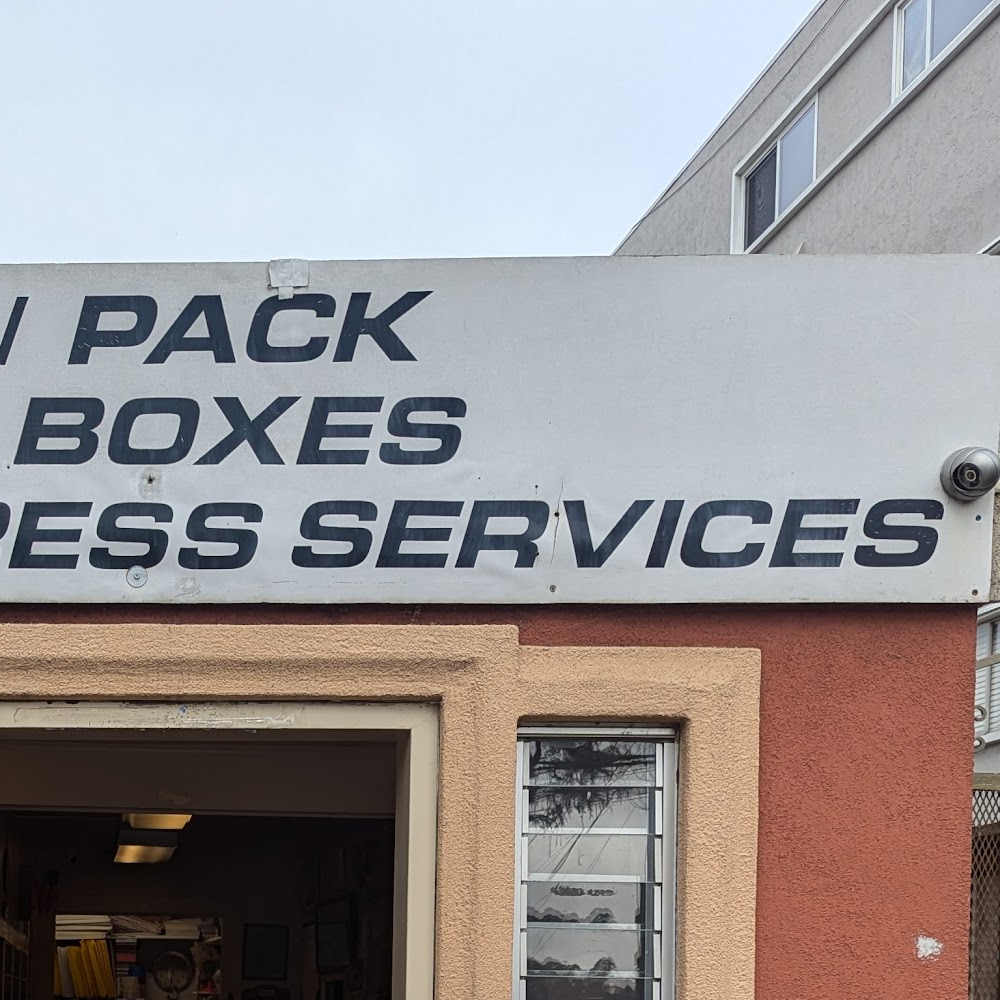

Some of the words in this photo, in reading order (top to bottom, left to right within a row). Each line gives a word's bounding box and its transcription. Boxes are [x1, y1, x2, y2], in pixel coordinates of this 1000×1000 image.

[67, 291, 434, 366] PACK
[13, 396, 468, 466] BOXES
[291, 497, 945, 569] SERVICES
